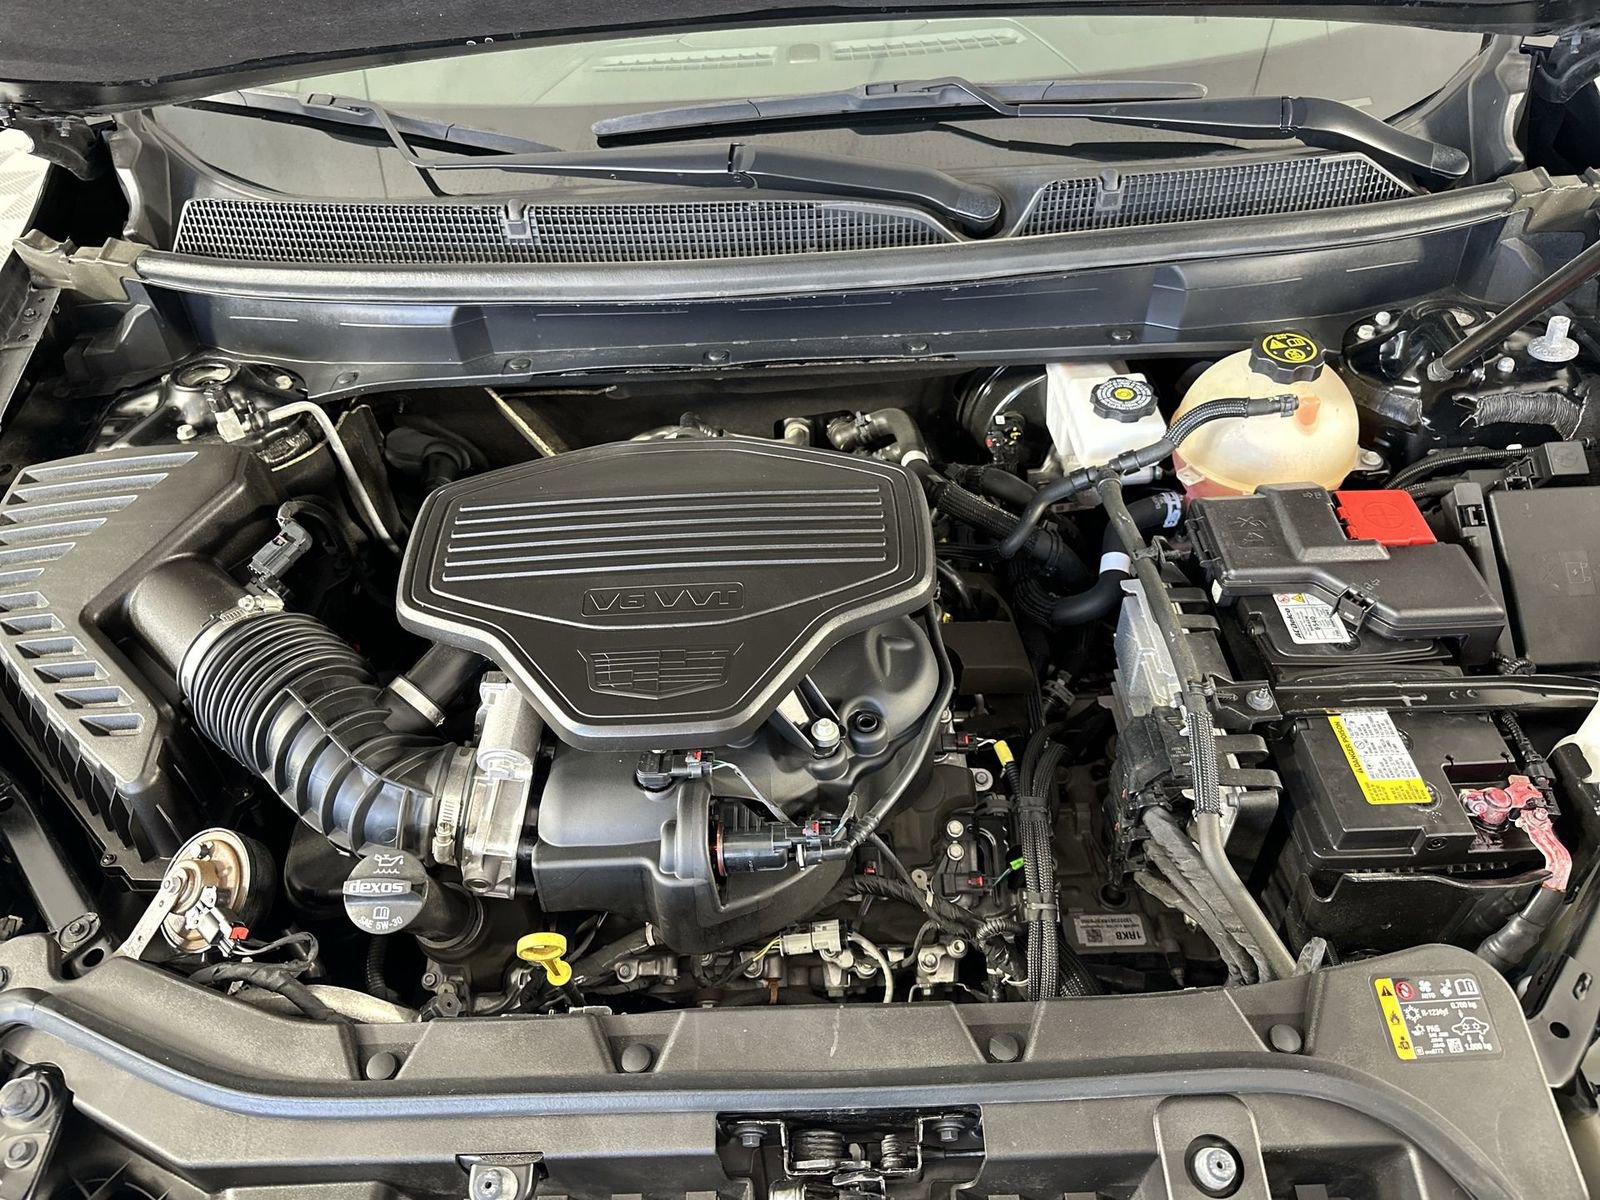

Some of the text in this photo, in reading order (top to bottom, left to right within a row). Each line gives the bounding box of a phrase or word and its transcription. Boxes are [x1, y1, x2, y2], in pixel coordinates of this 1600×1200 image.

[589, 589, 738, 611] V6 VVT
[1334, 721, 1361, 772] DANGER POISON
[348, 880, 404, 893] dexos
[358, 916, 403, 930] SAE 5W-30
